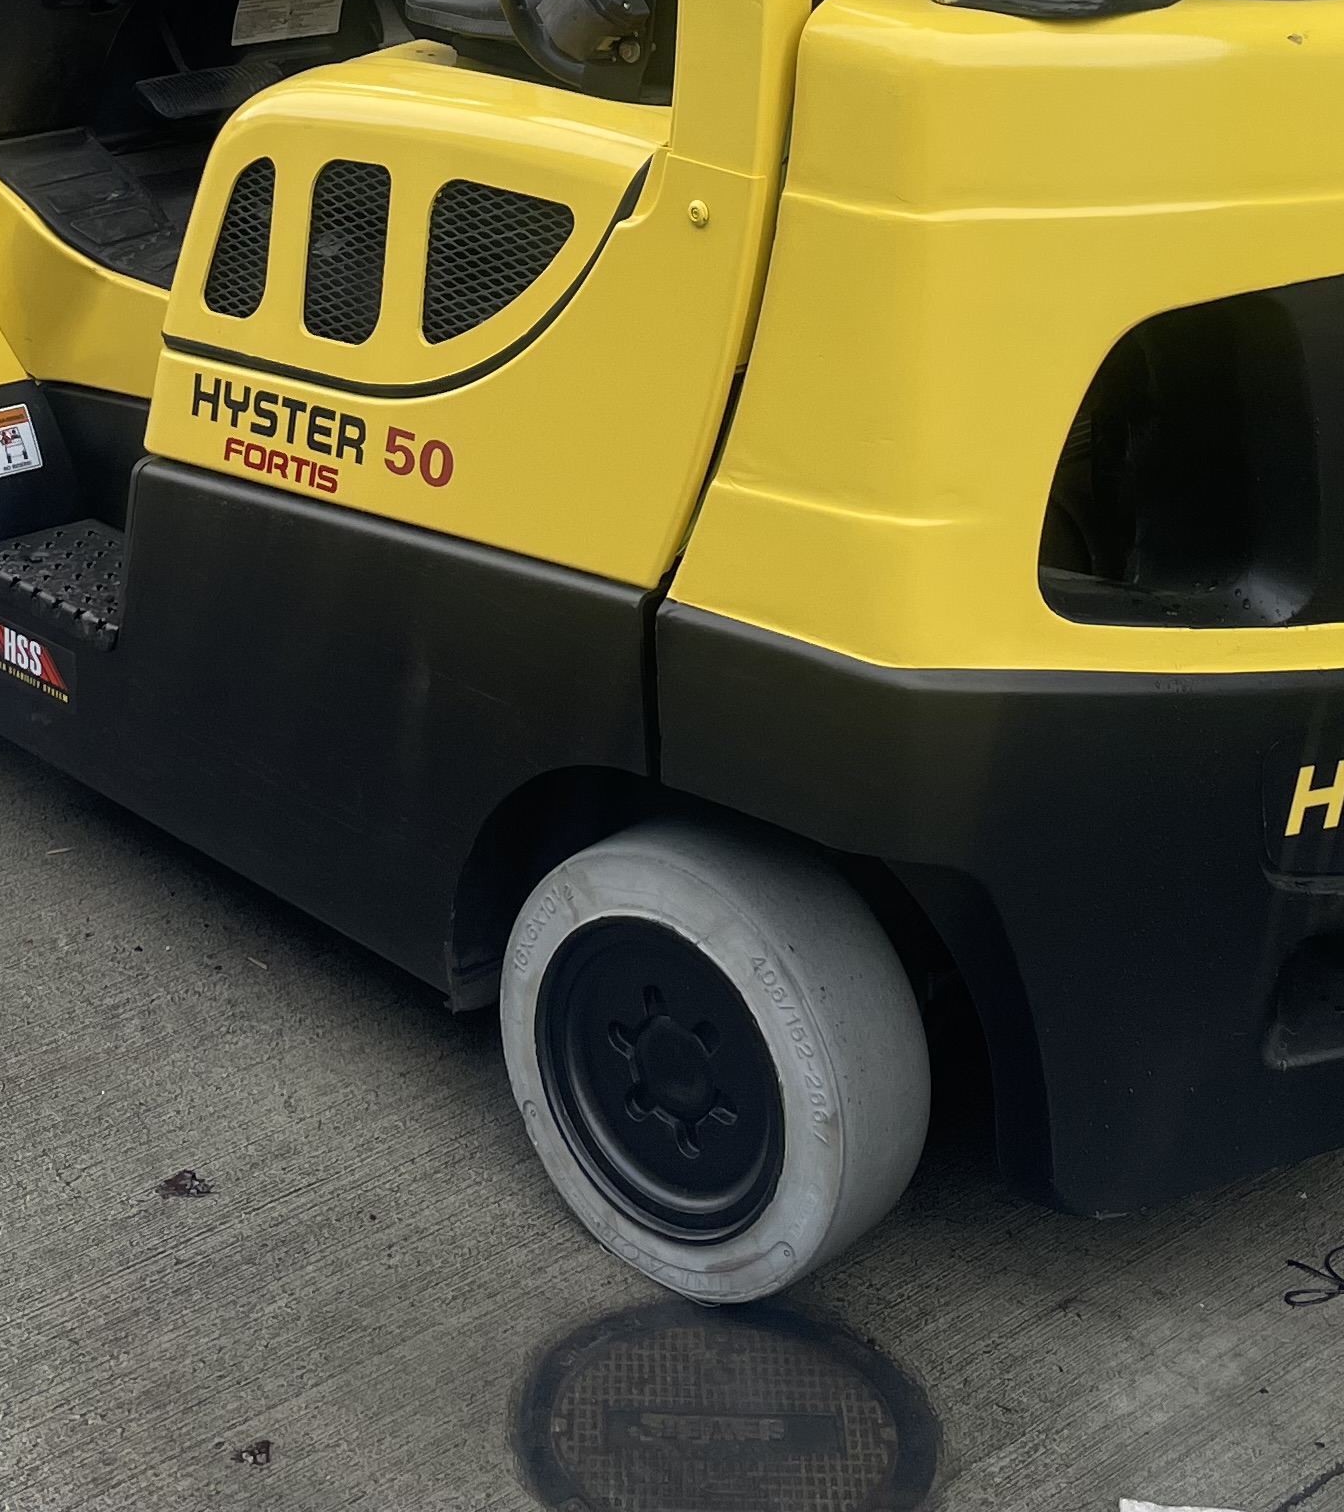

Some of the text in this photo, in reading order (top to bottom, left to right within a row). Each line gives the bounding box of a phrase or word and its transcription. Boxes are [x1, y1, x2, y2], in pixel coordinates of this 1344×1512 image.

[191, 372, 454, 488] HYSTER 50
[223, 437, 339, 494] FORTIS
[3, 626, 42, 677] HSS
